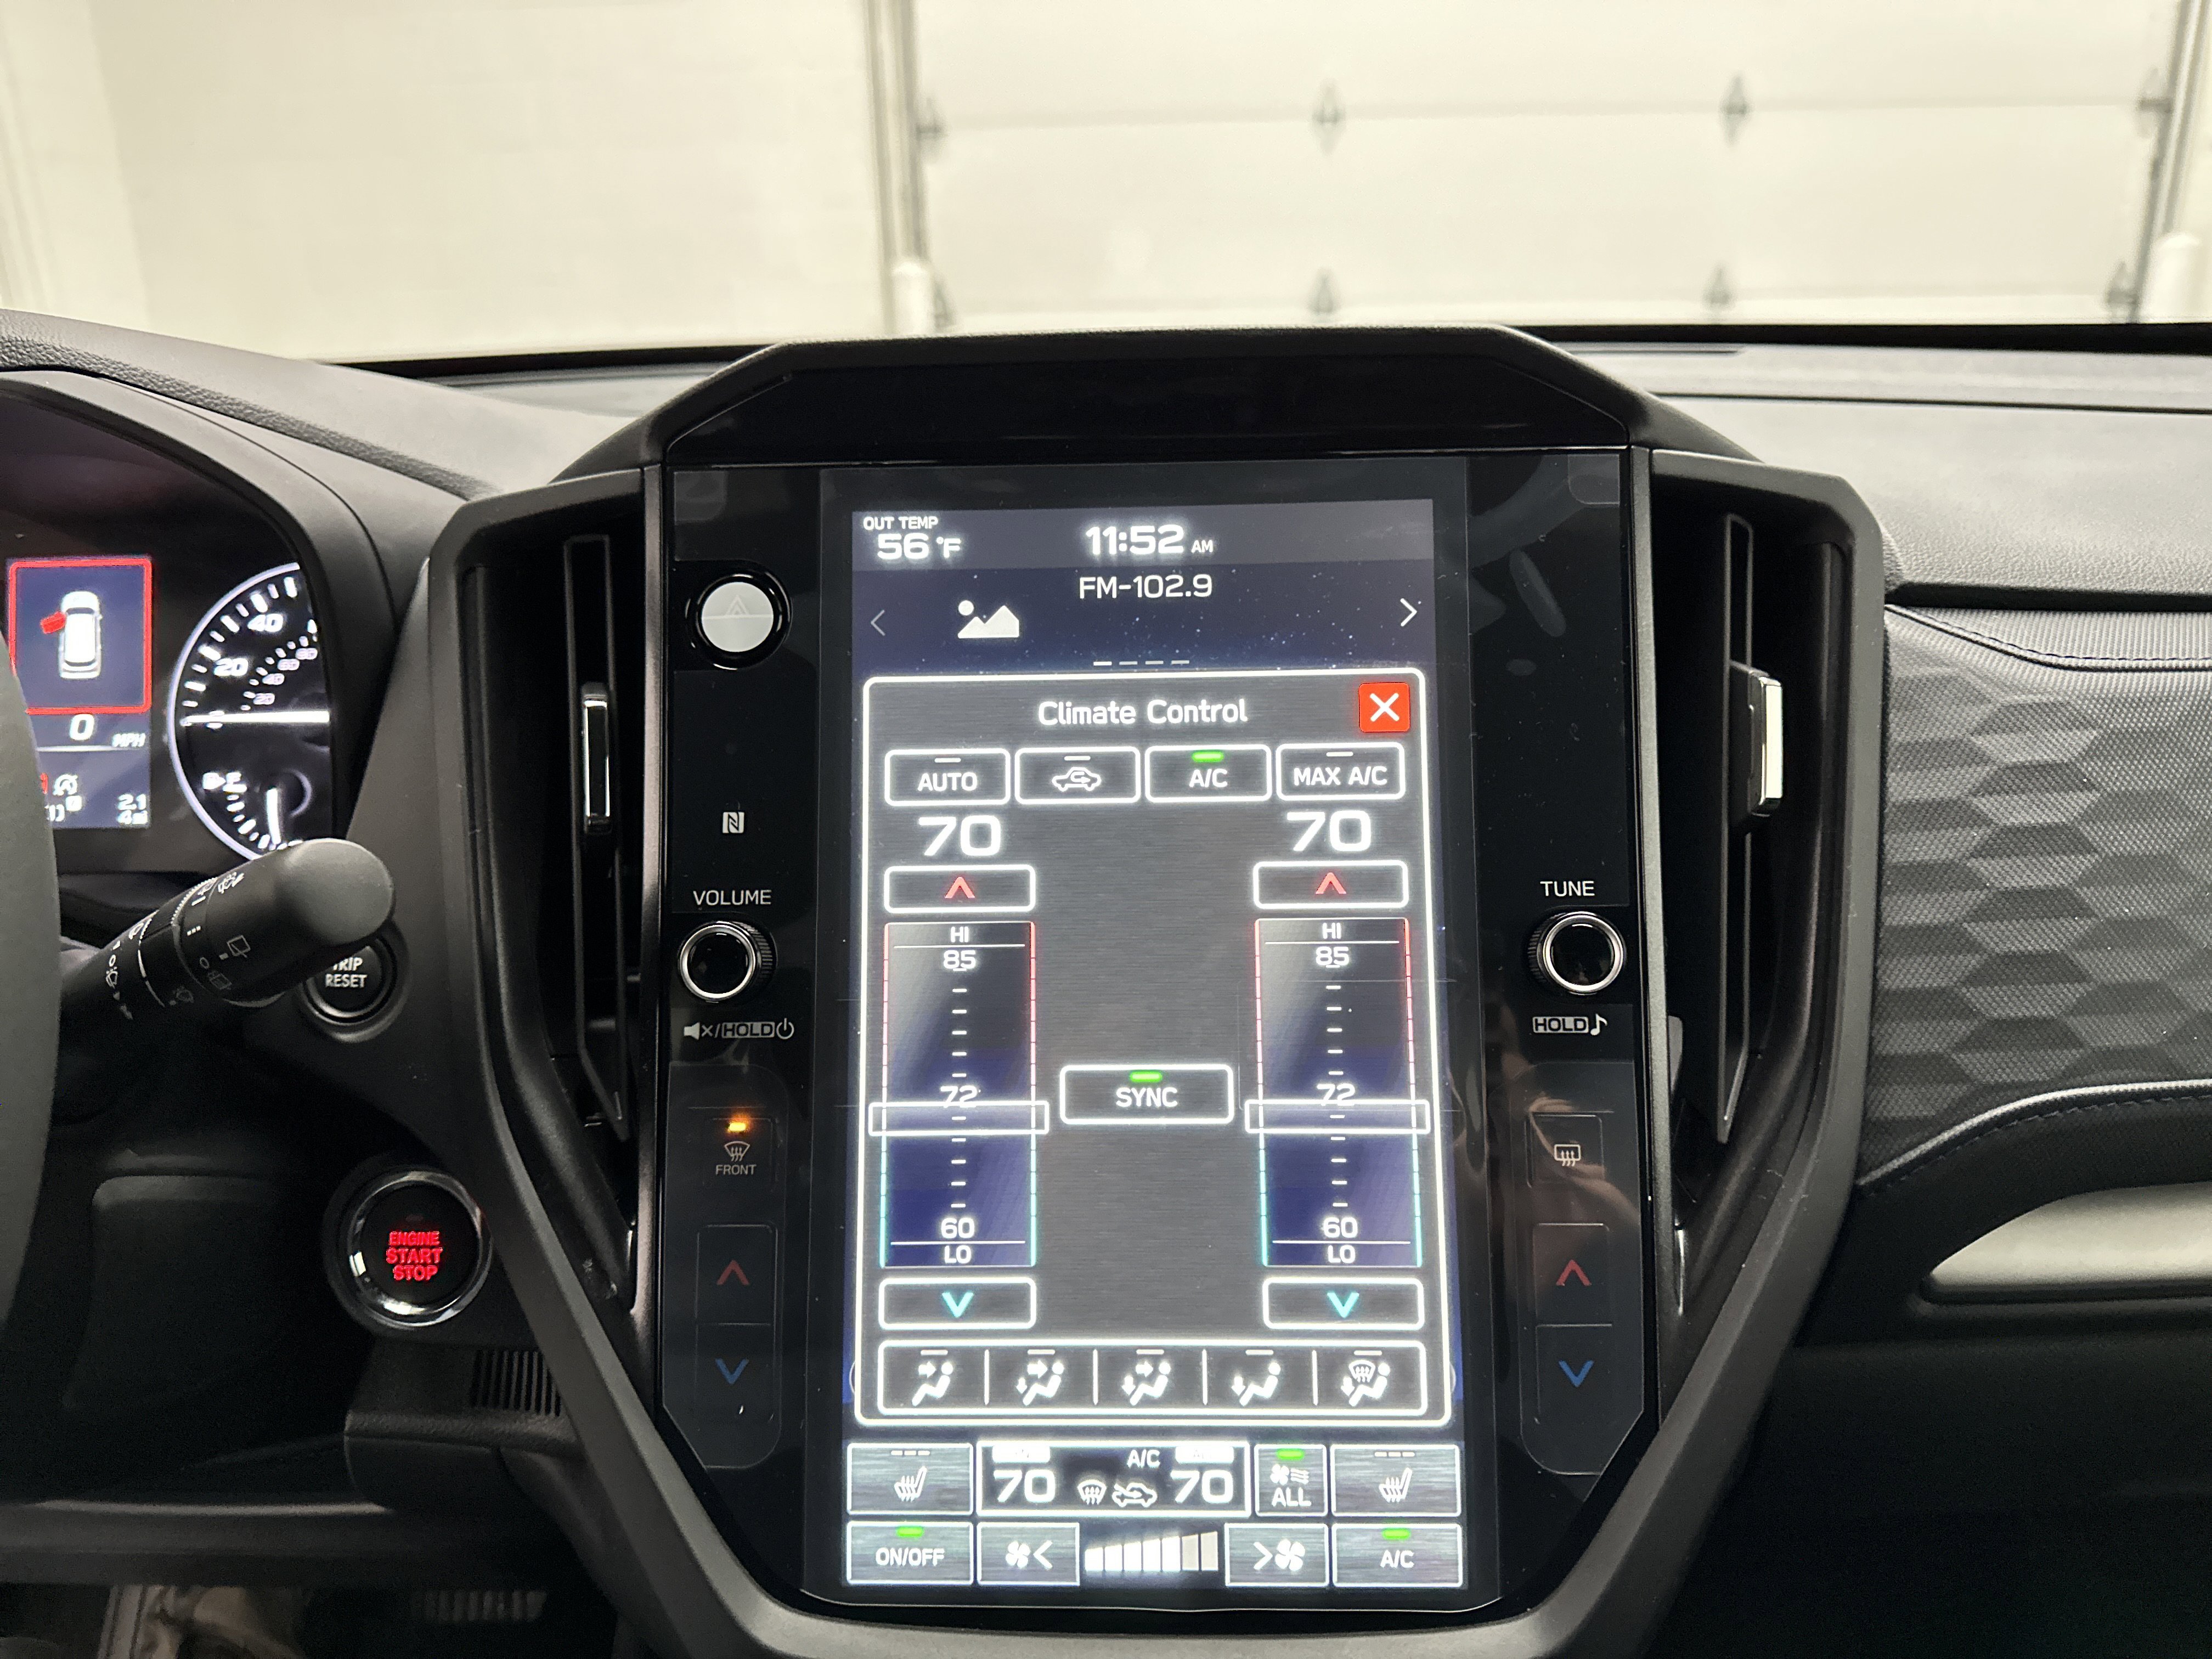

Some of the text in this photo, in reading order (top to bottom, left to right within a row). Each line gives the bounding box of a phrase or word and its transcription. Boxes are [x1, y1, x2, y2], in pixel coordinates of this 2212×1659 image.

[862, 515, 939, 529] OUT TEMP
[876, 533, 929, 561] 56
[1085, 523, 1215, 555] 11:52 AM
[1078, 573, 1214, 599] FM-102.9
[247, 613, 284, 632] 40
[213, 658, 249, 677] 20
[1037, 699, 1249, 727] Climate Control
[69, 713, 95, 741] 0
[112, 732, 146, 747] MPH
[917, 771, 978, 792] AUTO
[1188, 769, 1229, 790] A/C
[1293, 766, 1388, 787] MAX A/C
[918, 814, 1002, 857] 70
[1286, 810, 1372, 853] 70
[692, 889, 772, 906] VOLUME
[1540, 881, 1595, 897] TUNE
[950, 926, 970, 943] HI
[1321, 923, 1342, 939] HI
[943, 950, 977, 970] 85
[1316, 947, 1350, 967] 85
[325, 973, 368, 988] RESET
[1533, 1017, 1588, 1034] HOLD
[939, 1085, 979, 1109] 72
[1116, 1086, 1178, 1108] SYNC
[1317, 1083, 1356, 1107] 72
[714, 1164, 757, 1176] FRONT
[940, 1217, 975, 1239] 60
[1322, 1217, 1358, 1239] 60
[388, 1231, 440, 1246] ENGINE
[386, 1247, 443, 1264] START
[944, 1244, 972, 1264] LO
[1327, 1244, 1356, 1264] LO
[392, 1265, 438, 1281] STOP
[1127, 1448, 1161, 1468] A/C
[993, 1469, 1057, 1504] 70
[1170, 1469, 1235, 1504] 70
[1271, 1488, 1311, 1508] ALL
[876, 1547, 945, 1569] ON/OFF
[1380, 1549, 1415, 1570] A/C
